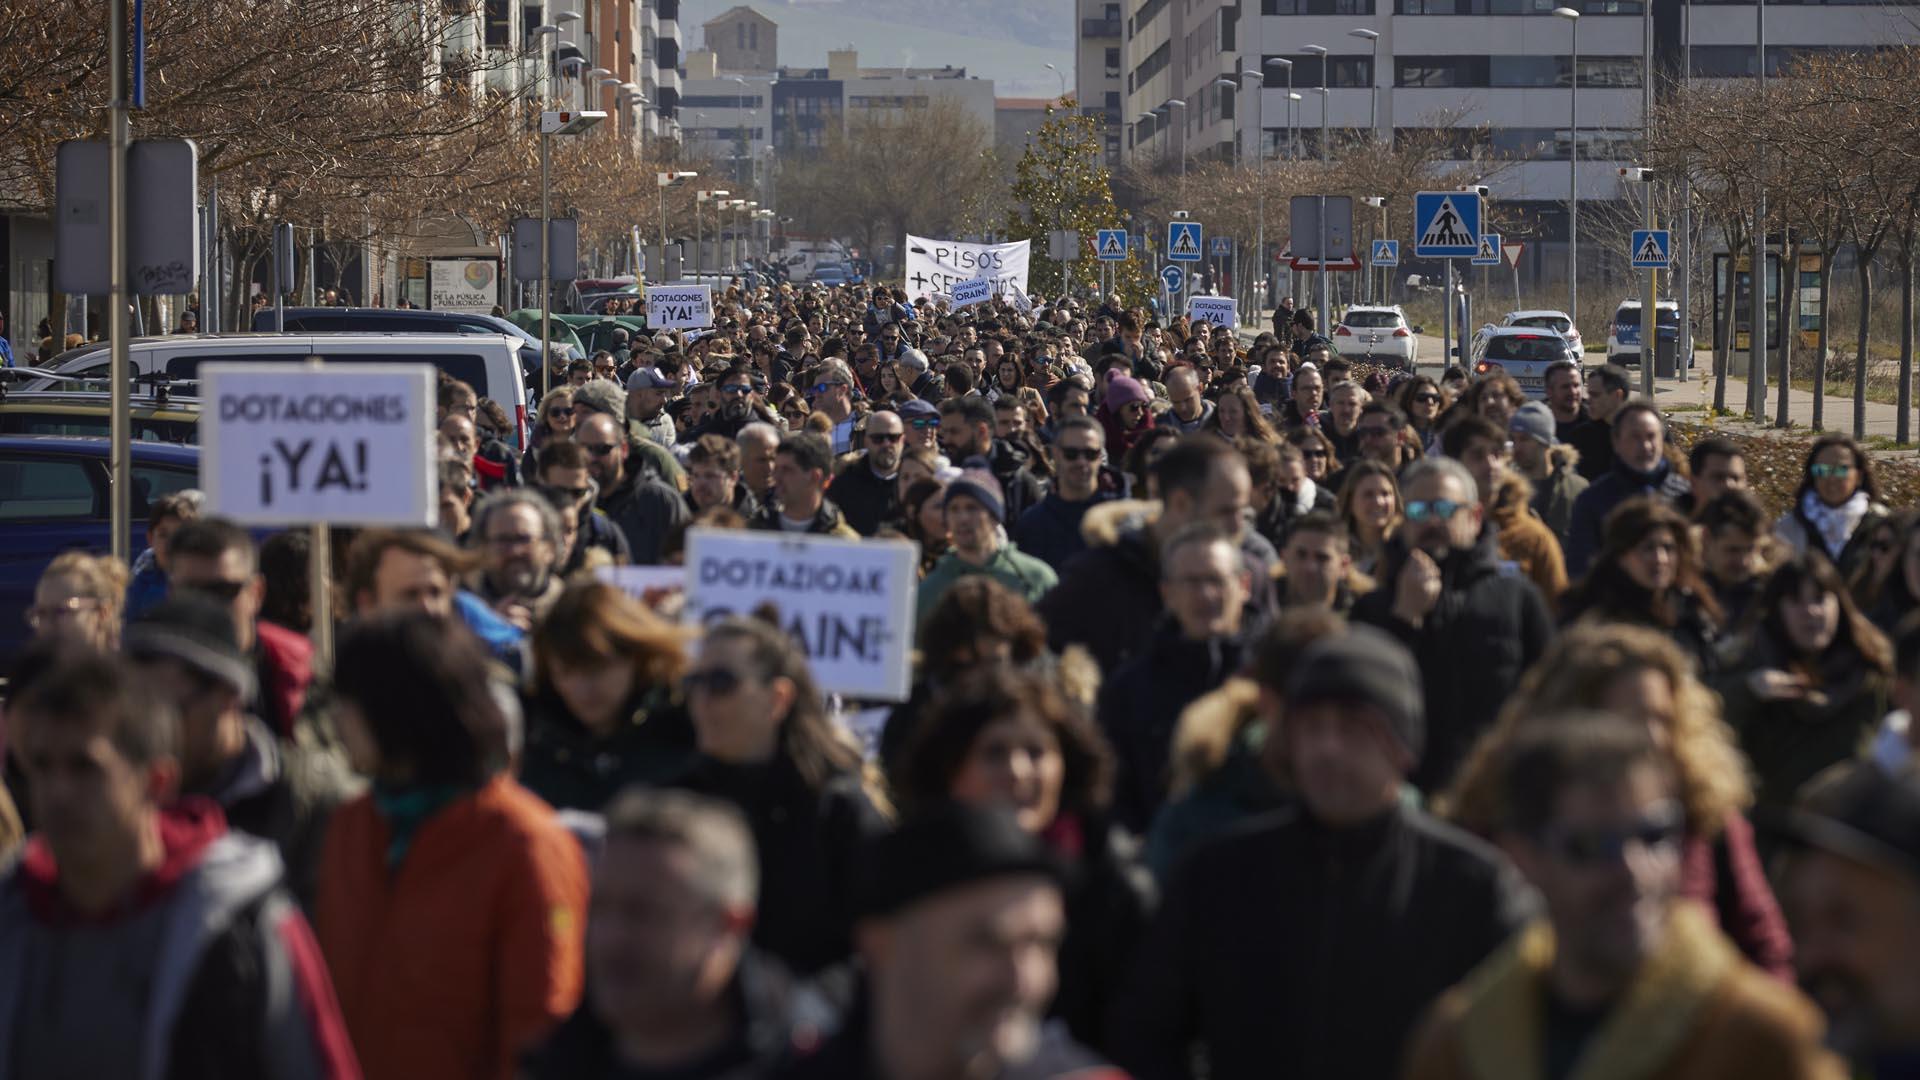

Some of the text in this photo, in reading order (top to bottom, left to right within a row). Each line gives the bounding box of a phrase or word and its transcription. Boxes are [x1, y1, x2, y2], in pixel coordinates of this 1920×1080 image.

[936, 245, 1003, 270] PISOS
[931, 272, 1017, 297] SEIOS
[954, 281, 985, 291] DOTAZIOAK
[955, 288, 987, 301] ORAIN!
[662, 305, 692, 325] ¡YA!
[219, 393, 406, 423] DOTACIONES
[259, 438, 368, 507] ¡YA!
[700, 557, 886, 594] DOTAZIOAK
